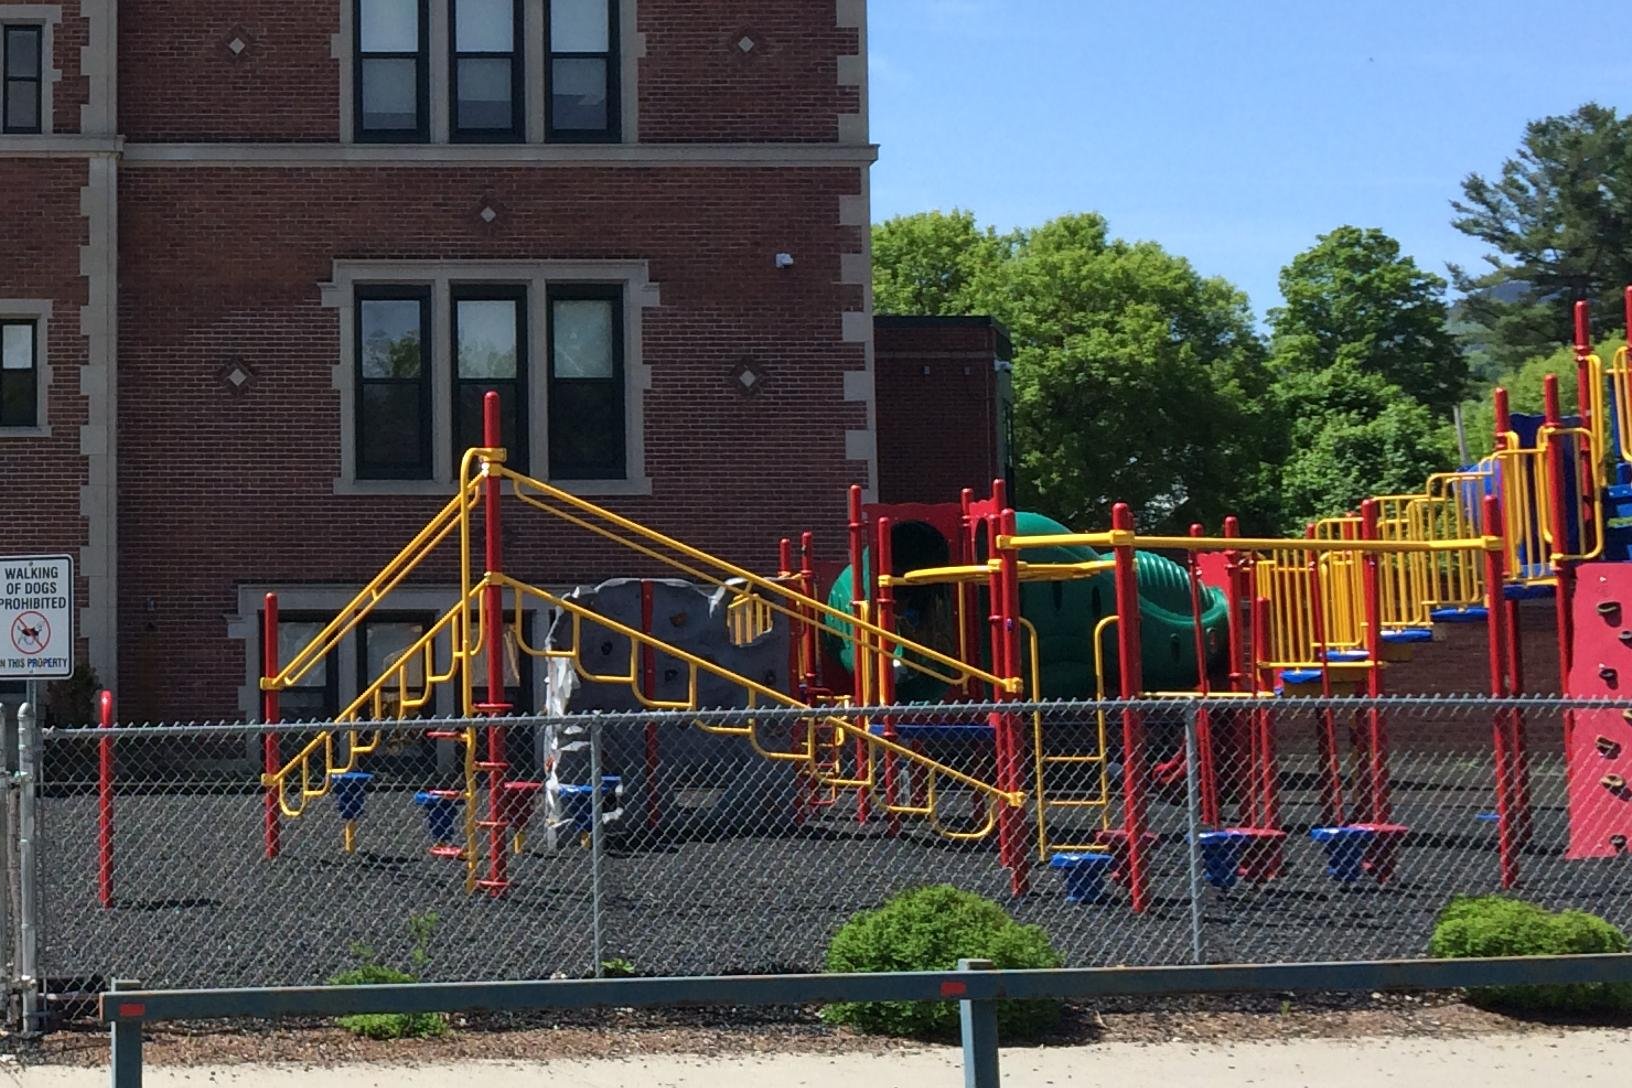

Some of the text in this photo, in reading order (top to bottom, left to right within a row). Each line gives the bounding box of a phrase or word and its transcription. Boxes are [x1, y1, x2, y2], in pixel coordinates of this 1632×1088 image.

[4, 567, 59, 580] WALKING
[6, 582, 57, 595] OF DOGS
[8, 658, 25, 668] THIS
[27, 657, 67, 668] PROPERTY
